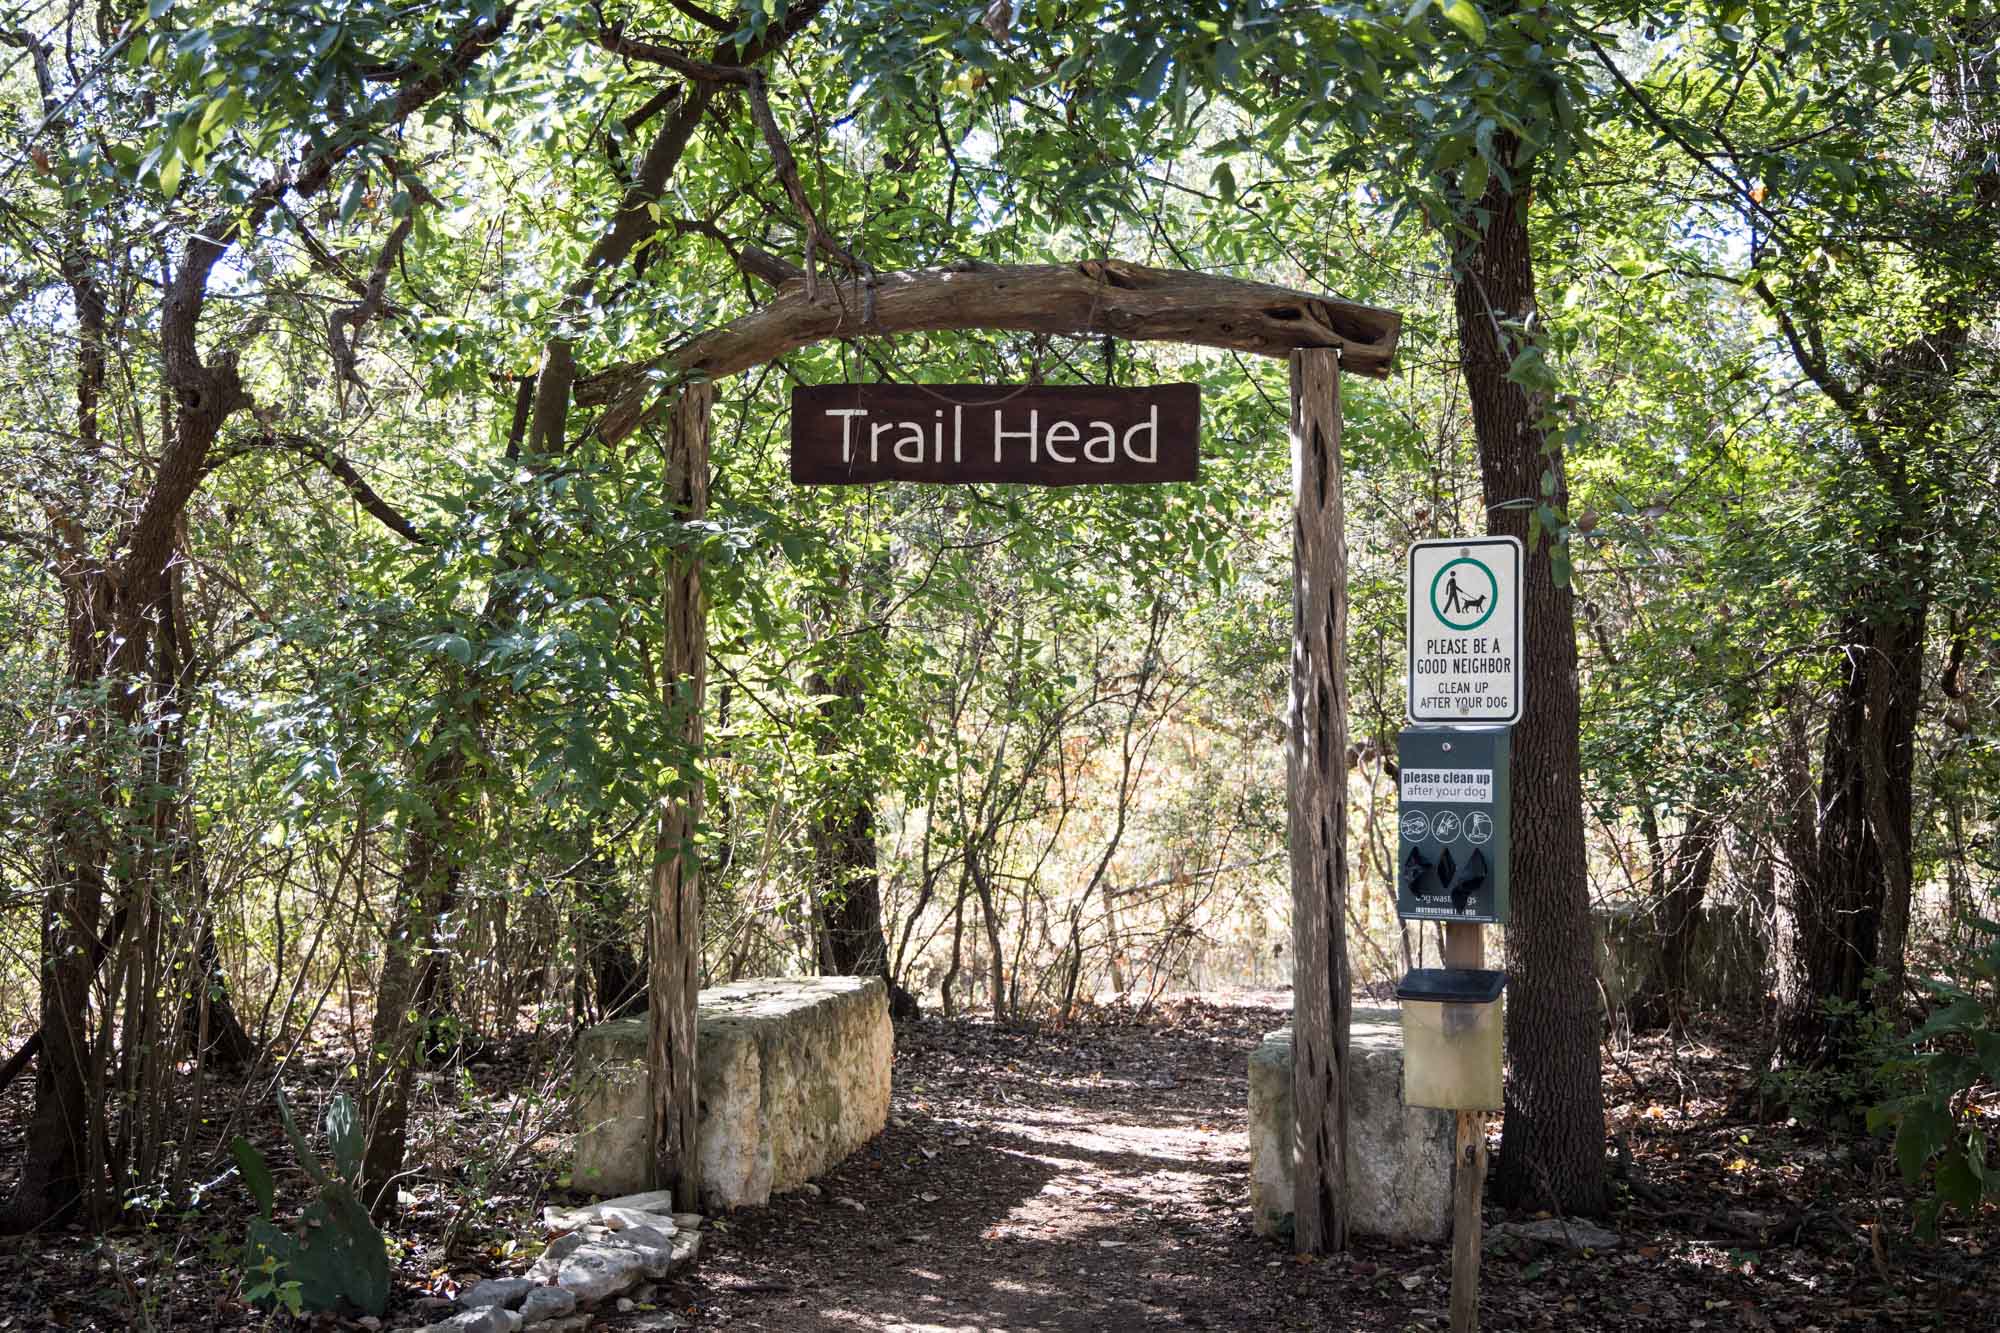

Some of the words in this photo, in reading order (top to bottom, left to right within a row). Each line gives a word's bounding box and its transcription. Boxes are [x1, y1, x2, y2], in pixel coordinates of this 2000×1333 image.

[825, 404, 962, 463] Trail
[994, 404, 1158, 463] Head
[1427, 639, 1468, 655] PLEASE
[1473, 638, 1488, 654] BE
[1492, 638, 1500, 654] A
[1417, 659, 1447, 674] GOOD
[1453, 658, 1511, 674] NEIGHBOR
[1438, 682, 1470, 694] CLEAN
[1475, 682, 1488, 693] UP
[1420, 697, 1451, 709] AFTER
[1455, 696, 1482, 709] YOUR
[1486, 697, 1508, 708] DOG
[1404, 772, 1440, 784] please
[1443, 772, 1474, 784] clean
[1476, 774, 1490, 785] up
[1407, 785, 1433, 796] after
[1436, 787, 1462, 798] your
[1464, 786, 1486, 800] dog
[1432, 895, 1452, 904] wast
